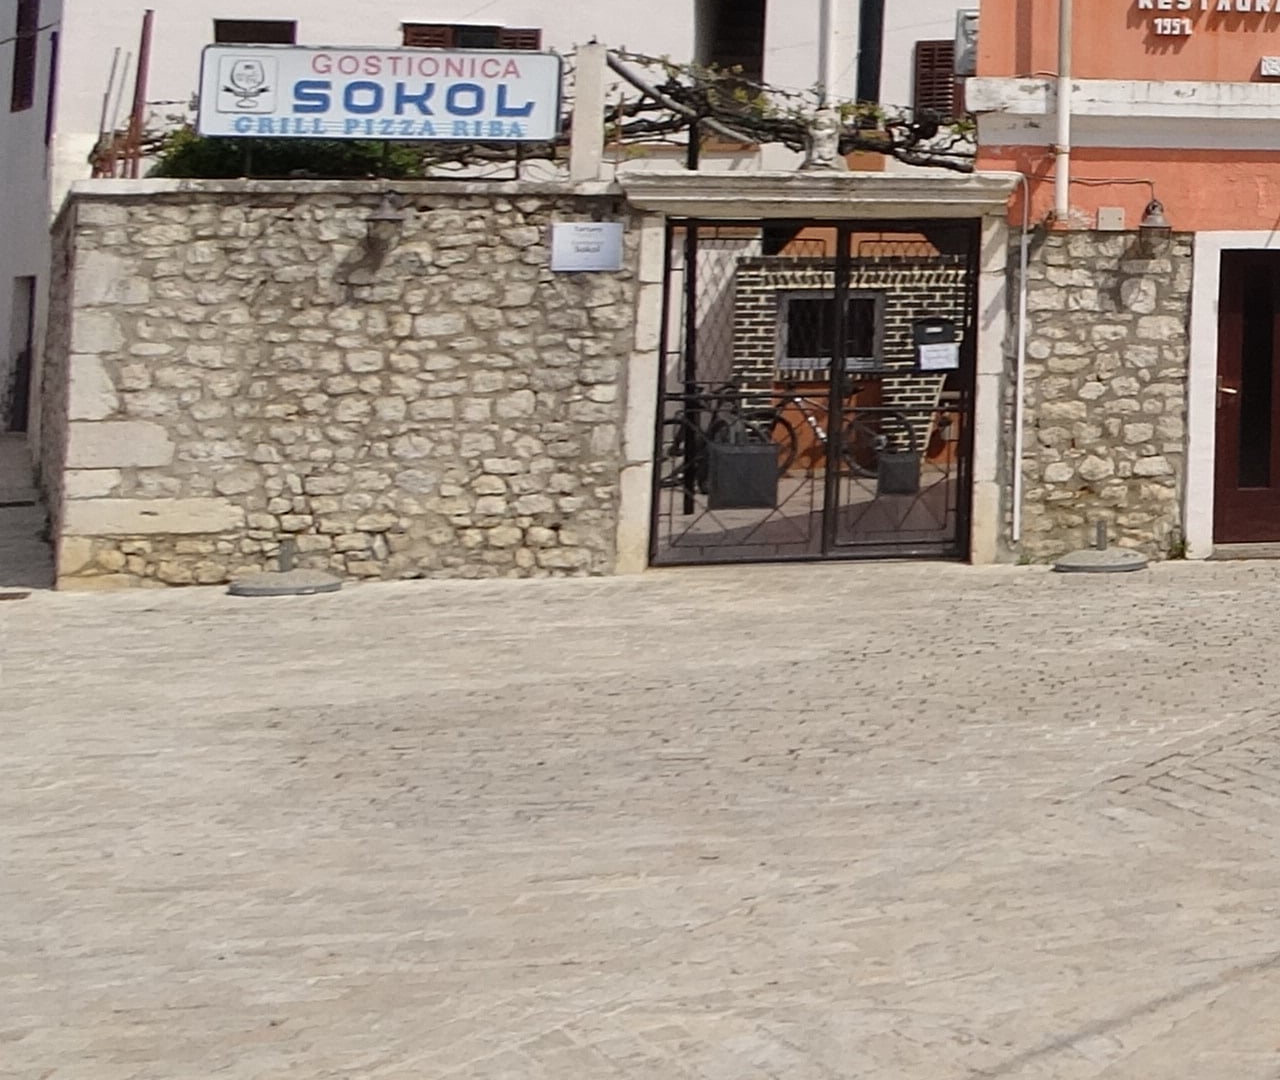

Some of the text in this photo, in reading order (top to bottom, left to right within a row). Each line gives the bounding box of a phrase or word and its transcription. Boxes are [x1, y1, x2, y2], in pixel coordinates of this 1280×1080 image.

[312, 54, 521, 78] GOSTIONICA
[292, 80, 536, 118] SOKOL
[234, 117, 525, 138] GRILL PIZZA RIBA
